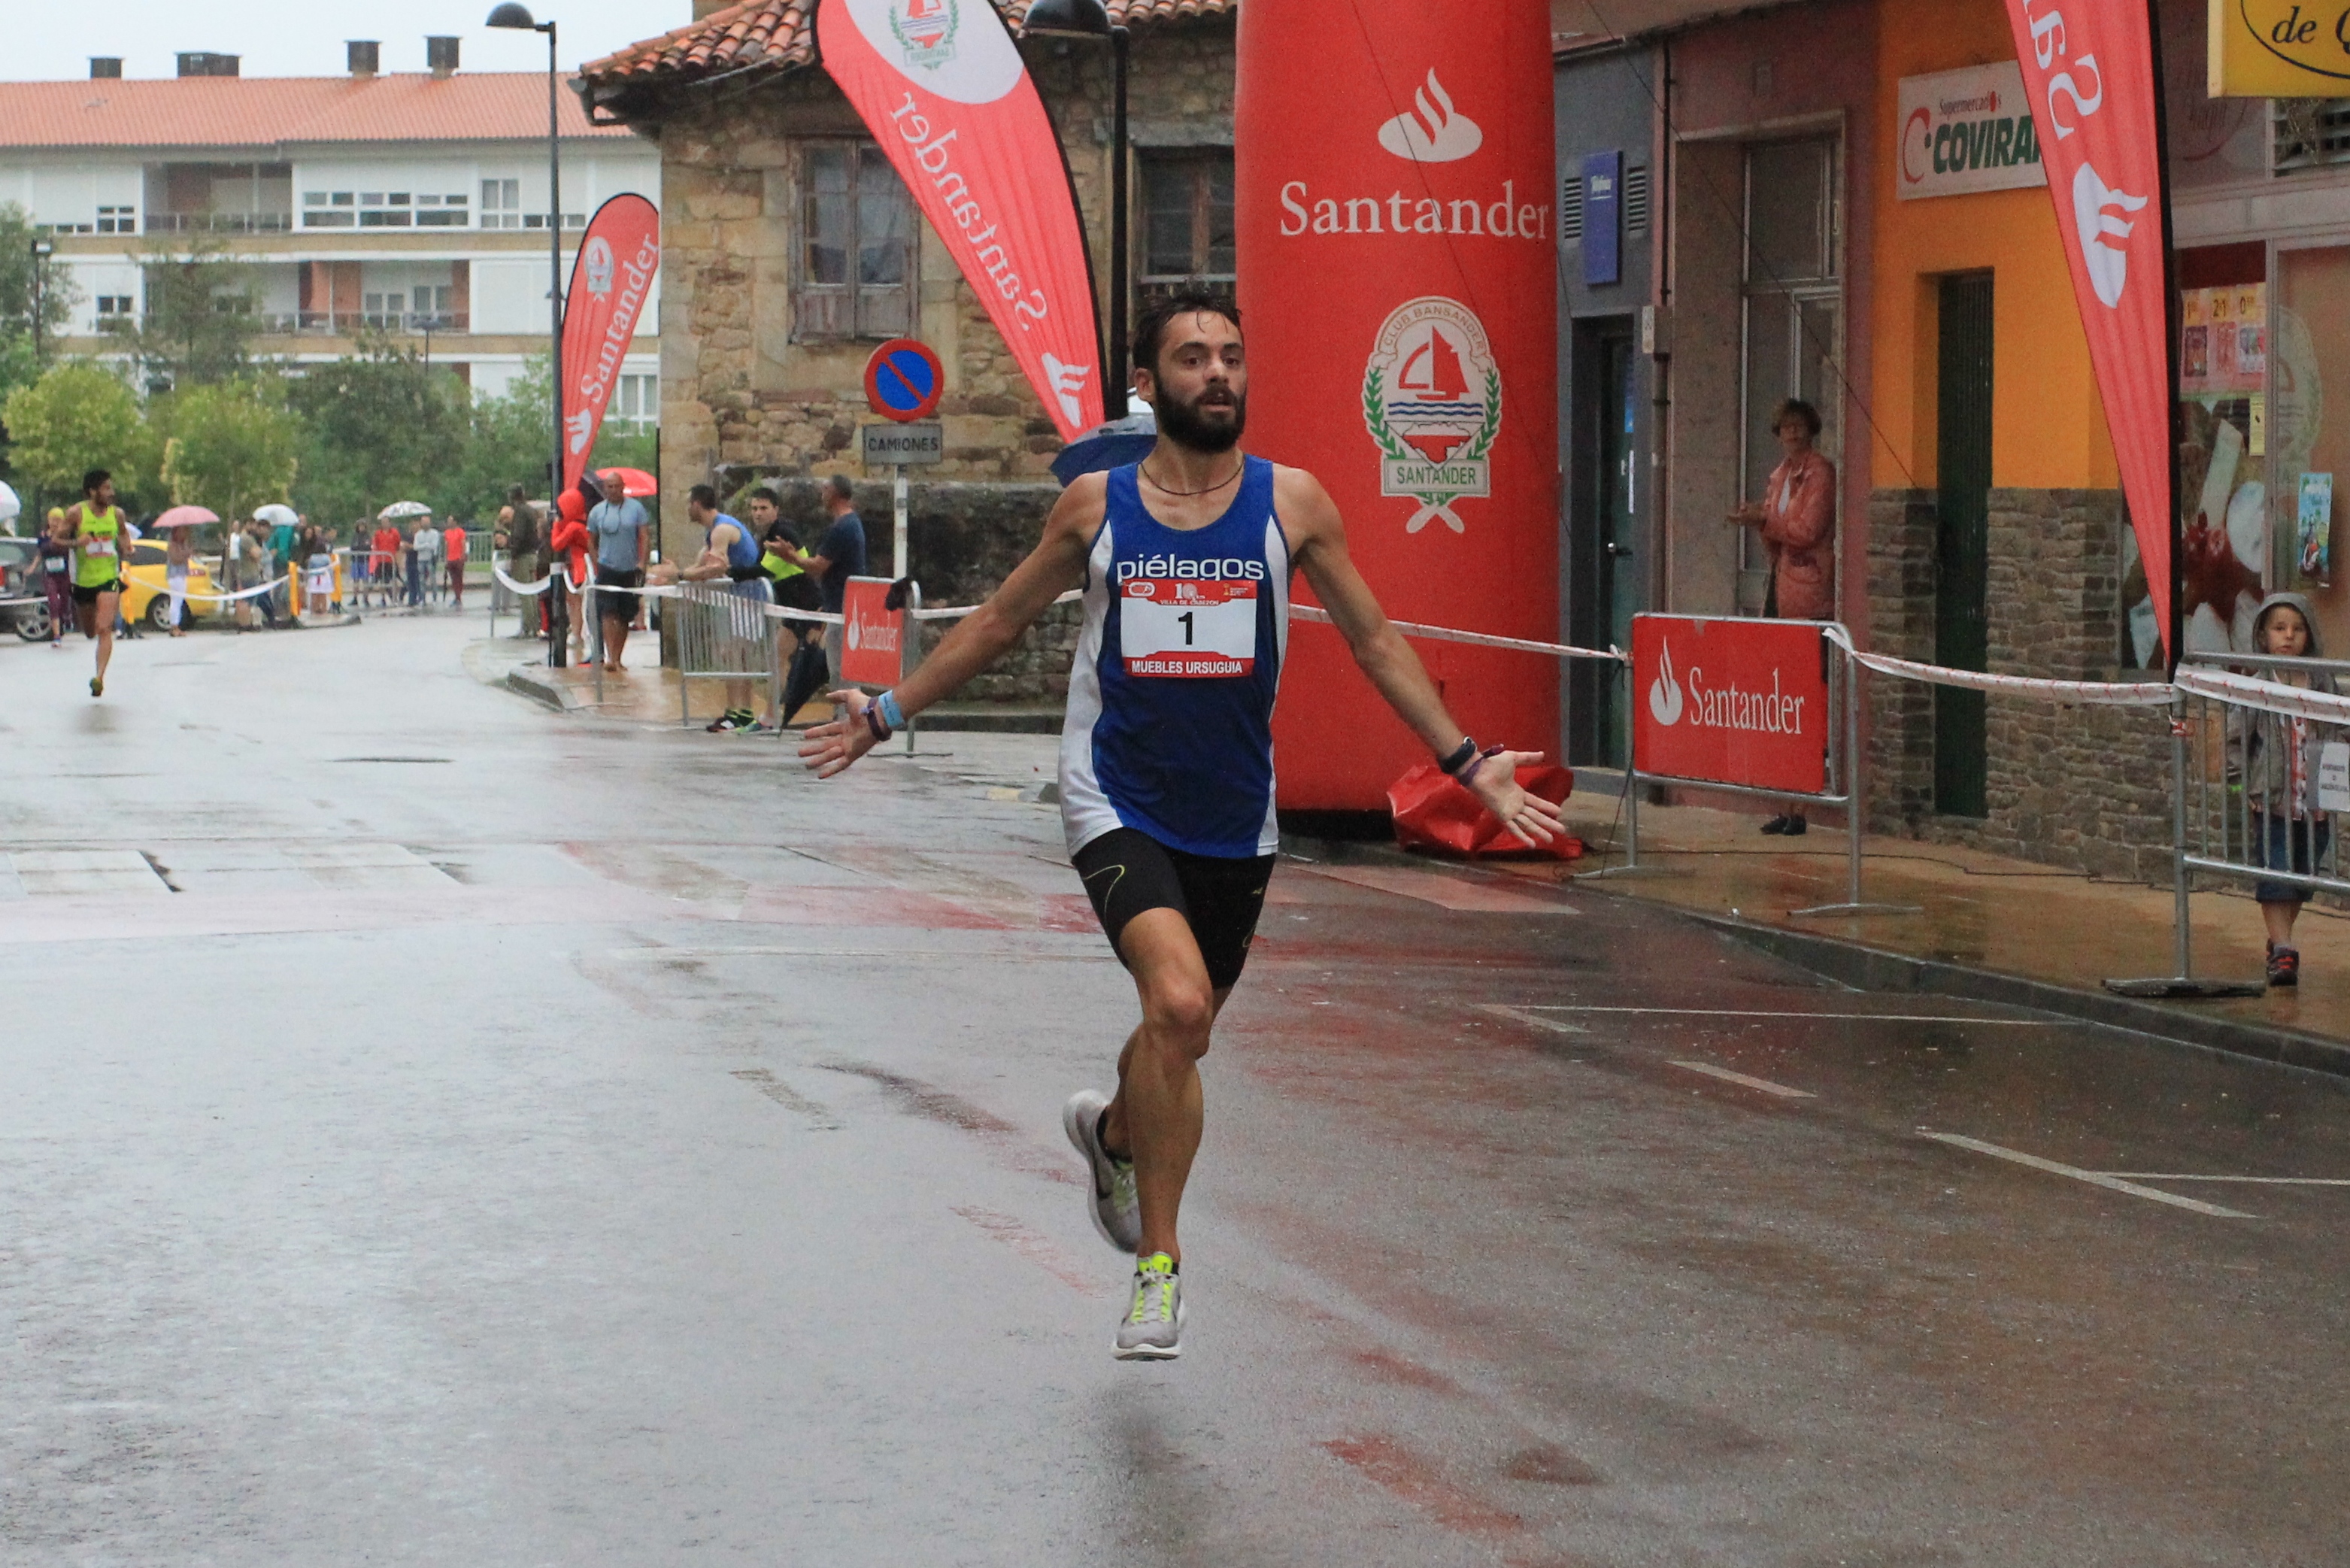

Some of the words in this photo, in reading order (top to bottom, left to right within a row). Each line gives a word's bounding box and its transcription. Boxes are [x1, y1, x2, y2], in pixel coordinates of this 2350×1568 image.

[2271, 5, 2317, 44] de
[1933, 115, 2040, 174] COVIRA
[1280, 179, 1550, 241] Santander
[581, 233, 659, 405] Santander
[1384, 313, 1411, 347] CLUB
[868, 437, 938, 451] CAMIONES
[1396, 466, 1477, 486] SANTANDER
[1117, 553, 1265, 586] piélagos
[1178, 611, 1193, 645] 1
[1131, 660, 1183, 674] MUEBLES
[1186, 660, 1243, 674] URSUGUIA
[1688, 666, 1805, 735] Santander
